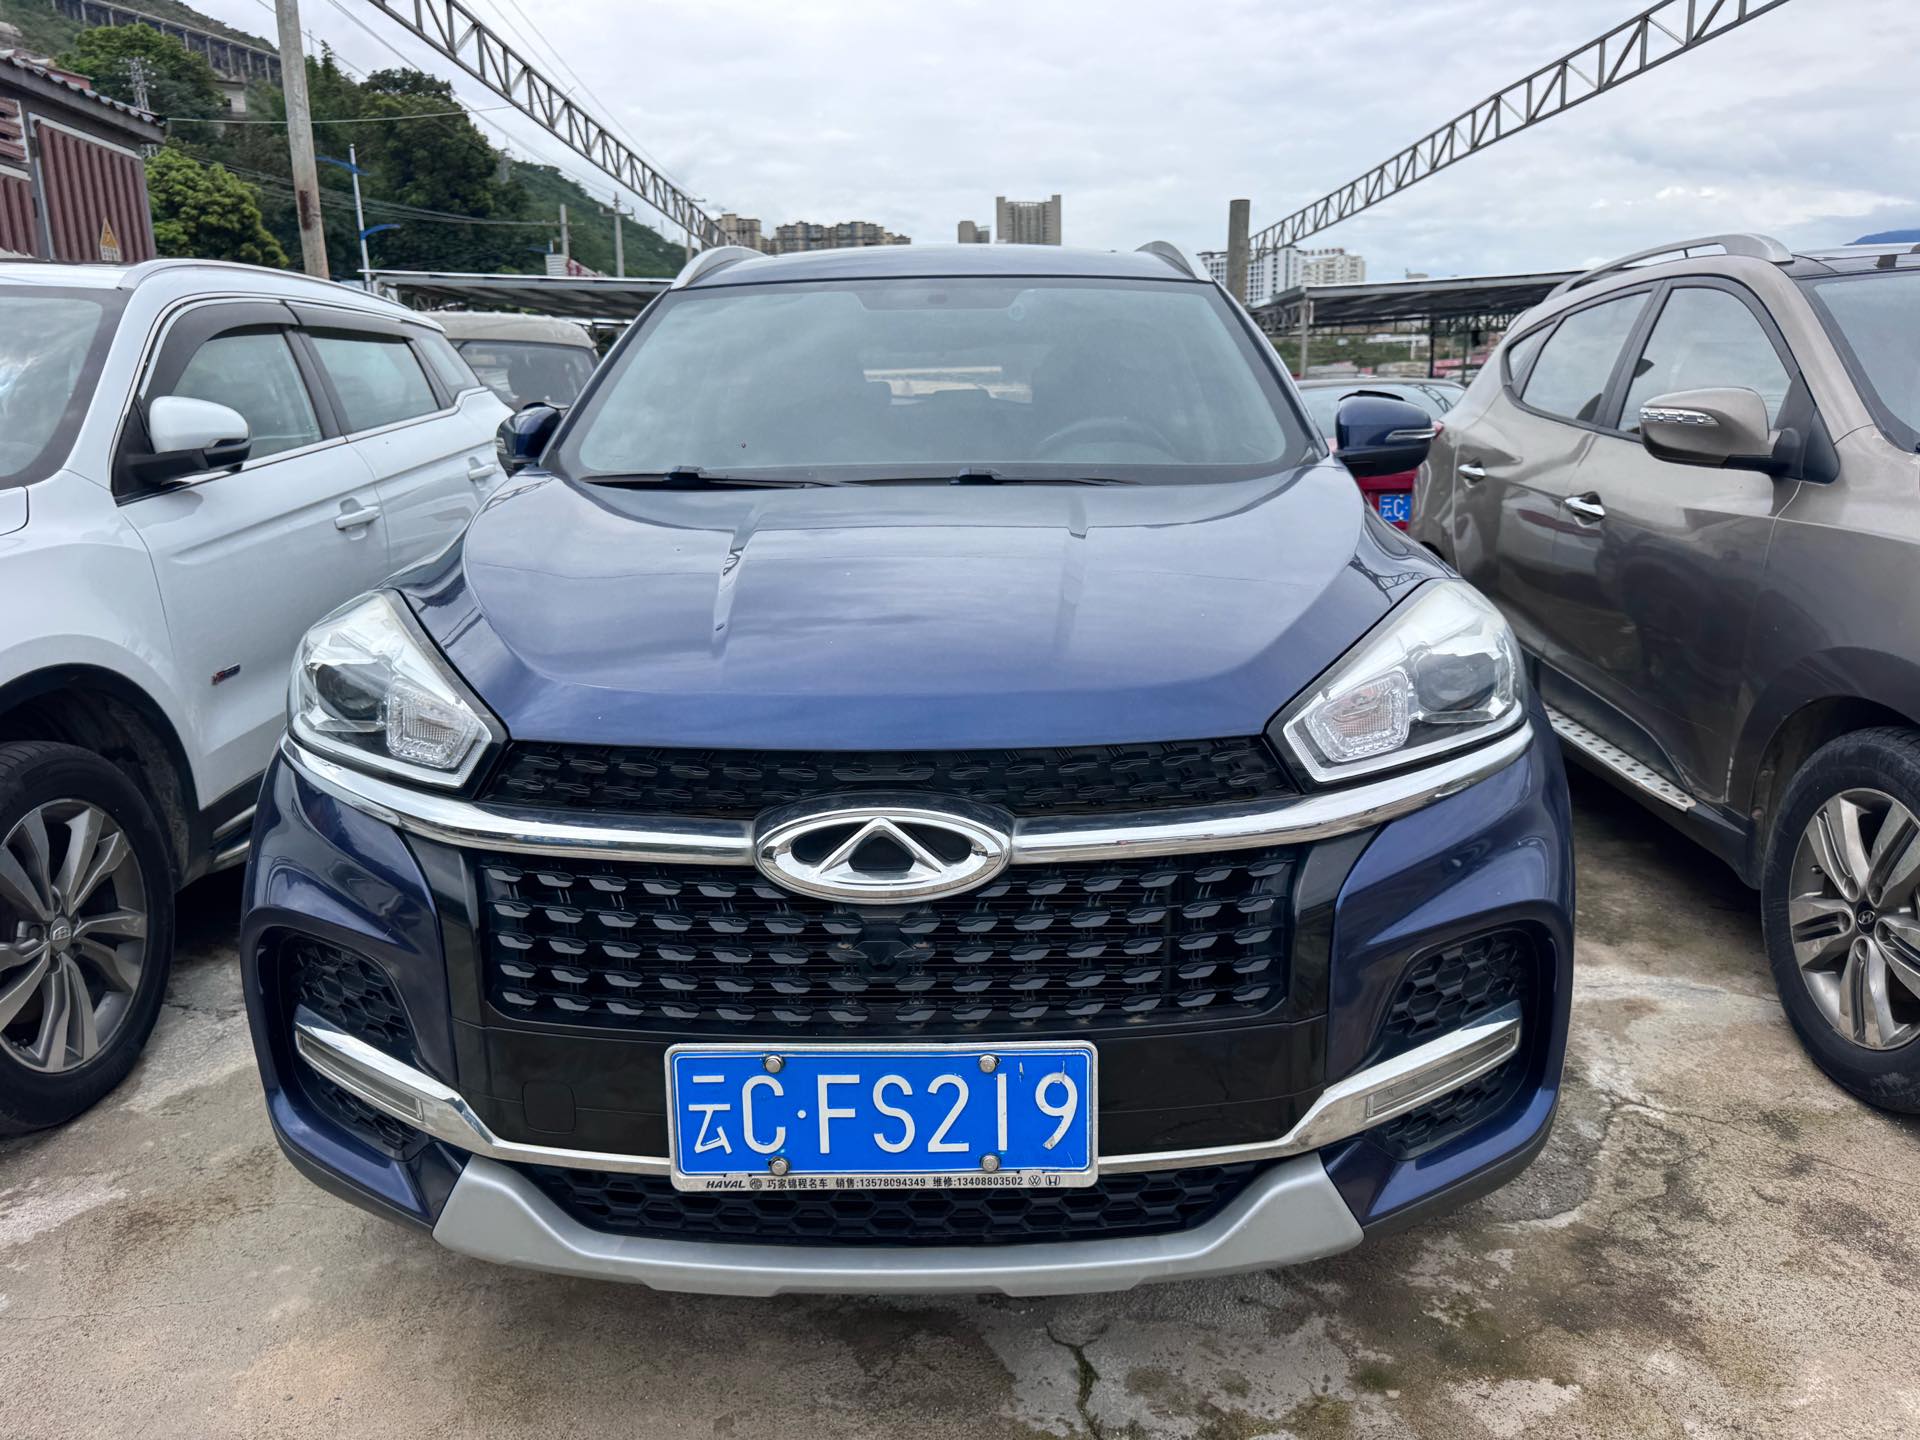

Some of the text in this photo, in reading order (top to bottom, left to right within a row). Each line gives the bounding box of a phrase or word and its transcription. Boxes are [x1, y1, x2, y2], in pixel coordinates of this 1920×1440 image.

[688, 1073, 1078, 1154] 云C·FS219
[706, 1179, 746, 1190] HAVAL
[767, 1178, 828, 1189] 巧家锦程名车
[835, 1177, 926, 1188] 销售:13578094349
[932, 1176, 1023, 1187] 维修:13408803502
